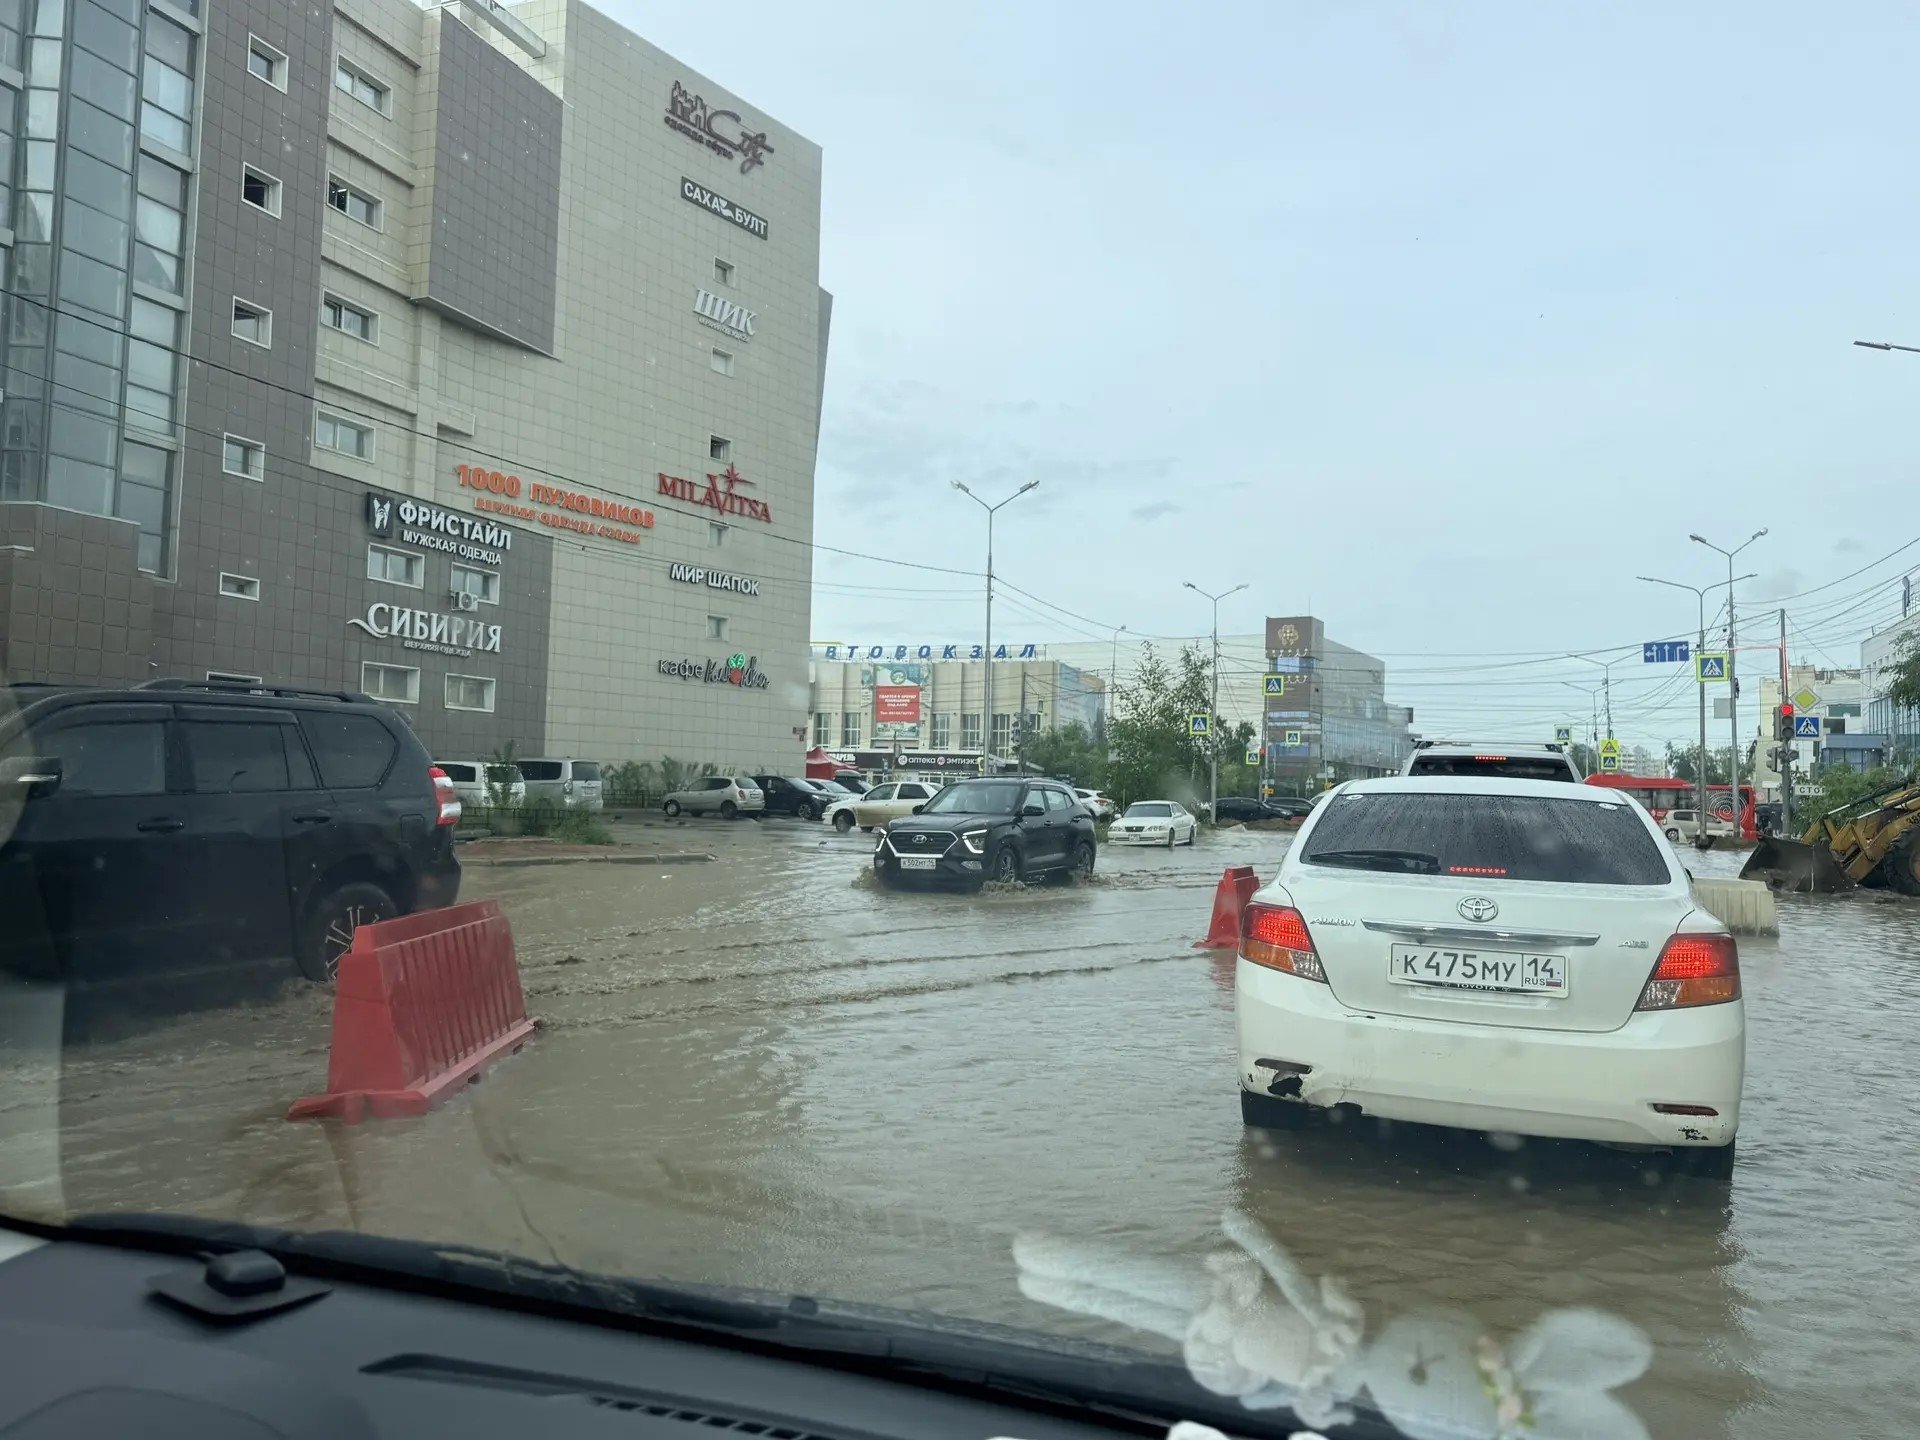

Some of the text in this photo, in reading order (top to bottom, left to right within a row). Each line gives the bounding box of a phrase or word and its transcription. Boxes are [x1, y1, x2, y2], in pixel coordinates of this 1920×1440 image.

[684, 182, 767, 235] САХА БУЛТ
[692, 288, 758, 336] ШИК
[457, 464, 656, 528] 1000 ПУХОВИКОВ
[657, 472, 772, 523] MILAVITSA
[399, 500, 512, 550] ФРИСТАЙЛ
[403, 529, 502, 565] МУЖСКАЯ ОДЕЖДА
[671, 563, 760, 596] МИР ШАПОК
[366, 602, 502, 654] СИБИРИЯ
[809, 643, 1036, 660] ВТОВОКЗАЛ
[658, 659, 704, 681] кафе
[1524, 977, 1546, 987] RUS
[1527, 957, 1554, 978] 14
[1457, 983, 1497, 991] TOYOTA
